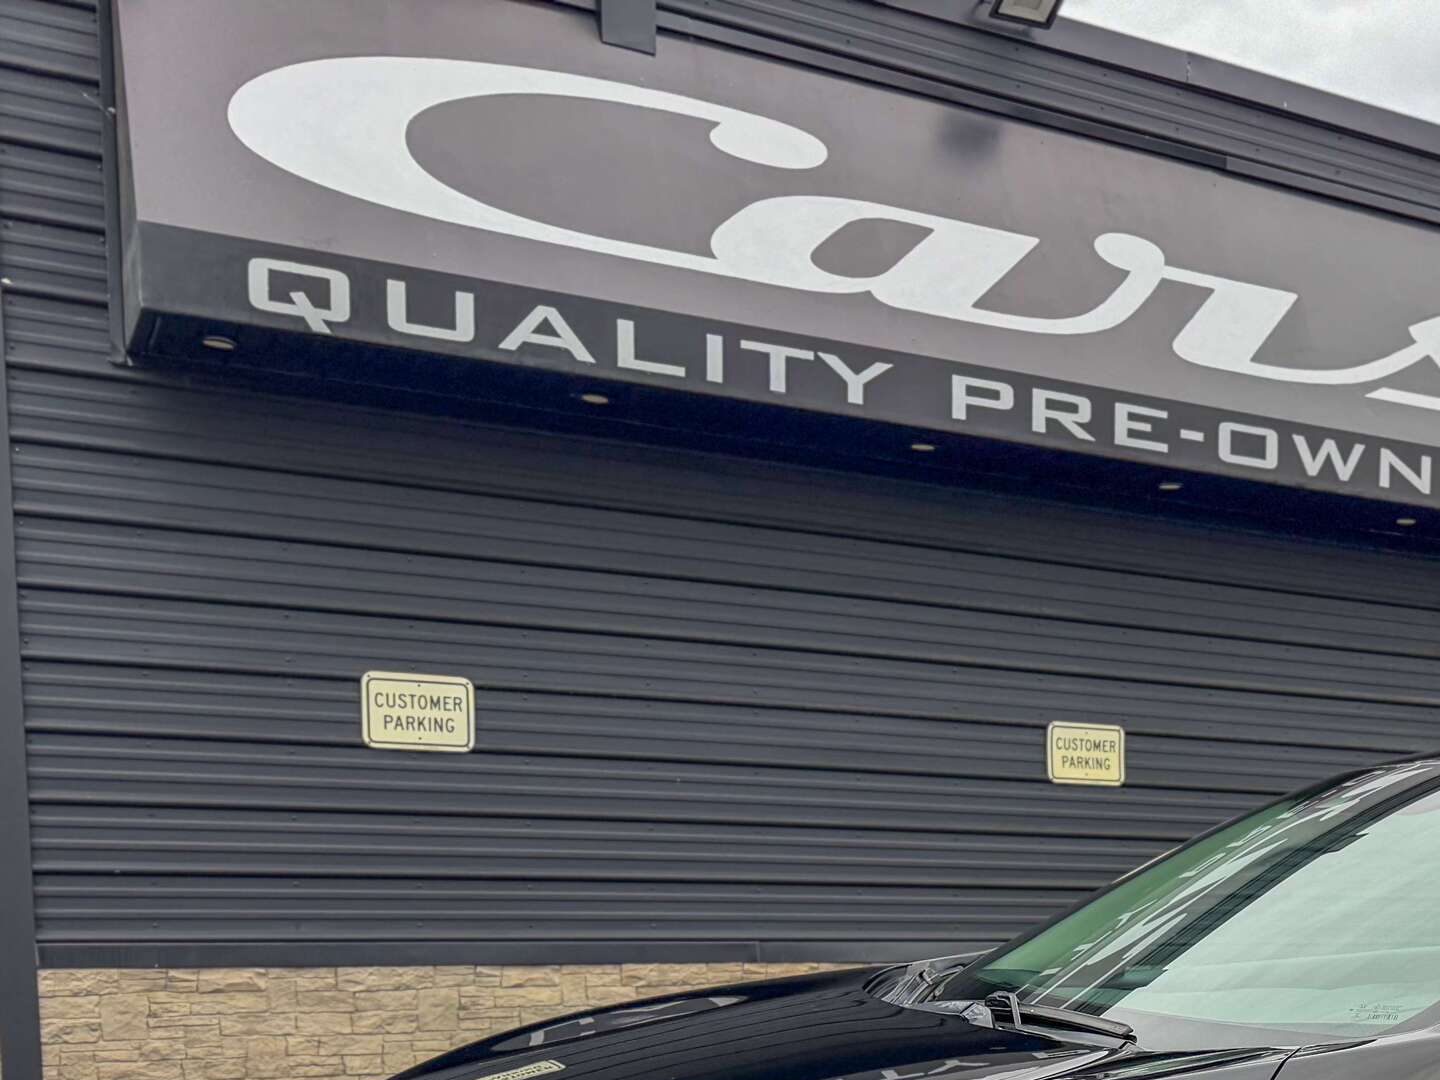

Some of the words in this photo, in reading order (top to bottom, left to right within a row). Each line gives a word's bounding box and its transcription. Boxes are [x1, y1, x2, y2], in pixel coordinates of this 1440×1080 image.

[247, 257, 893, 405] QUALITY
[374, 692, 463, 712] CUSTOMER
[384, 715, 455, 733] PARKING
[1056, 737, 1116, 753] CUSTOMER
[1062, 756, 1111, 770] PARKING
